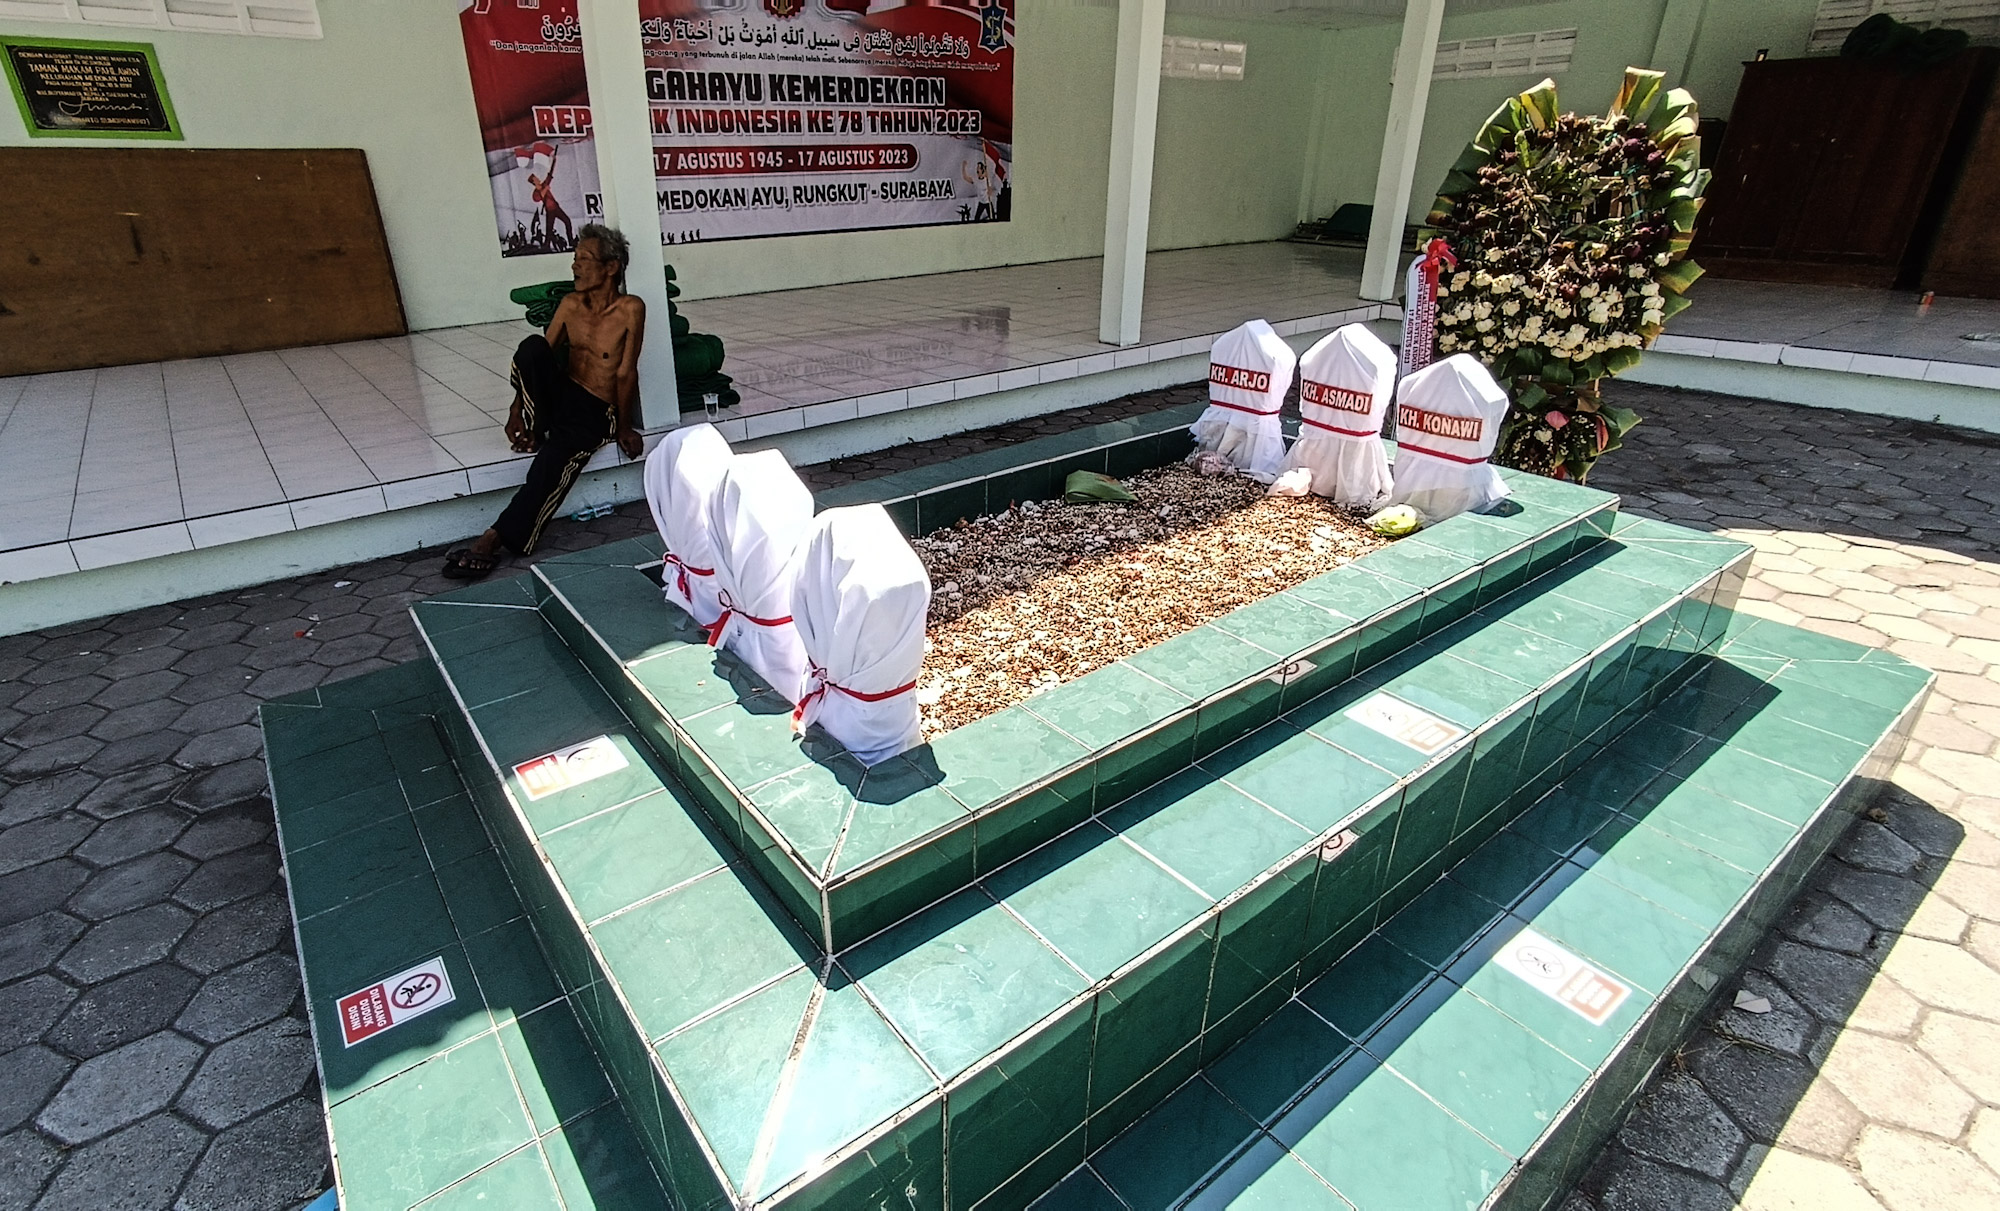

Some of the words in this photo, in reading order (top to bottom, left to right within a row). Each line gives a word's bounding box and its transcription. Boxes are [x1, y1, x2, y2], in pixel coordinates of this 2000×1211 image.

[28, 63, 59, 73] TAMAN
[61, 64, 94, 74] MAKAM
[95, 66, 140, 77] PAHLAWAN
[40, 73, 84, 81] KELURAHAN
[644, 69, 764, 102] GAHAYU
[767, 73, 945, 105] KEMERDEKAAN
[676, 108, 802, 134] INDONESIA
[806, 109, 834, 134] KE
[838, 109, 863, 134] 78
[866, 109, 934, 134] TAHUN
[935, 109, 981, 135] 2023
[652, 153, 672, 170] 17
[677, 151, 745, 170] AGUSTUS
[748, 150, 784, 169] 1945
[798, 150, 813, 167] 17
[818, 149, 875, 167] AGUSTUS
[878, 148, 909, 165] 2023
[657, 186, 747, 212] MEDOKAN
[751, 183, 790, 209] AYU,
[793, 182, 868, 206] RUNGKUT
[881, 178, 954, 200] SURABAYA
[1409, 309, 1415, 317] 17
[1405, 317, 1414, 348] AGUSTUS
[1413, 322, 1421, 345] UNTUK
[1418, 323, 1428, 362] INDONESIA
[1210, 364, 1228, 386] KH.
[1230, 369, 1269, 391] ARJO
[1302, 381, 1319, 402] KH.
[1321, 388, 1370, 414] ASMADI
[1400, 406, 1420, 428] KH.
[1422, 412, 1480, 440] KONAWI
[348, 1005, 362, 1031] DISINI
[359, 998, 374, 1027] DUDUK
[370, 988, 387, 1027] DILARANG
